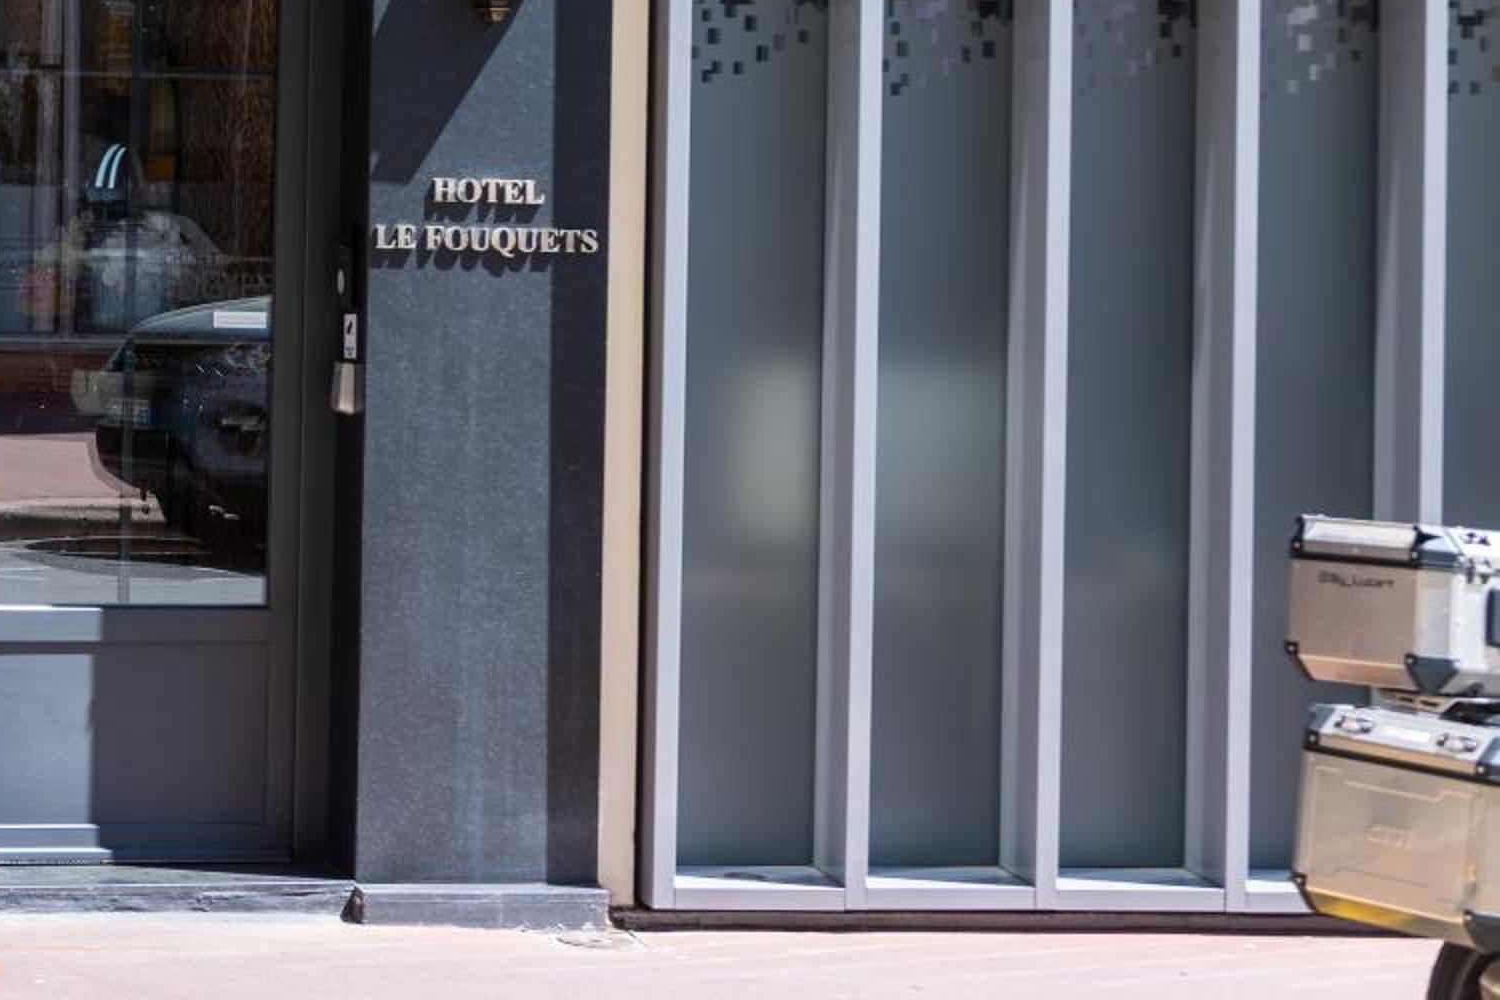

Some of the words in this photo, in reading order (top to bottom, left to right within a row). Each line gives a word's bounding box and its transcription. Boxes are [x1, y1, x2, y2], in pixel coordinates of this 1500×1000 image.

[432, 177, 545, 205] HOTEL
[374, 223, 417, 250] LE
[425, 226, 599, 258] FOUQUETS
